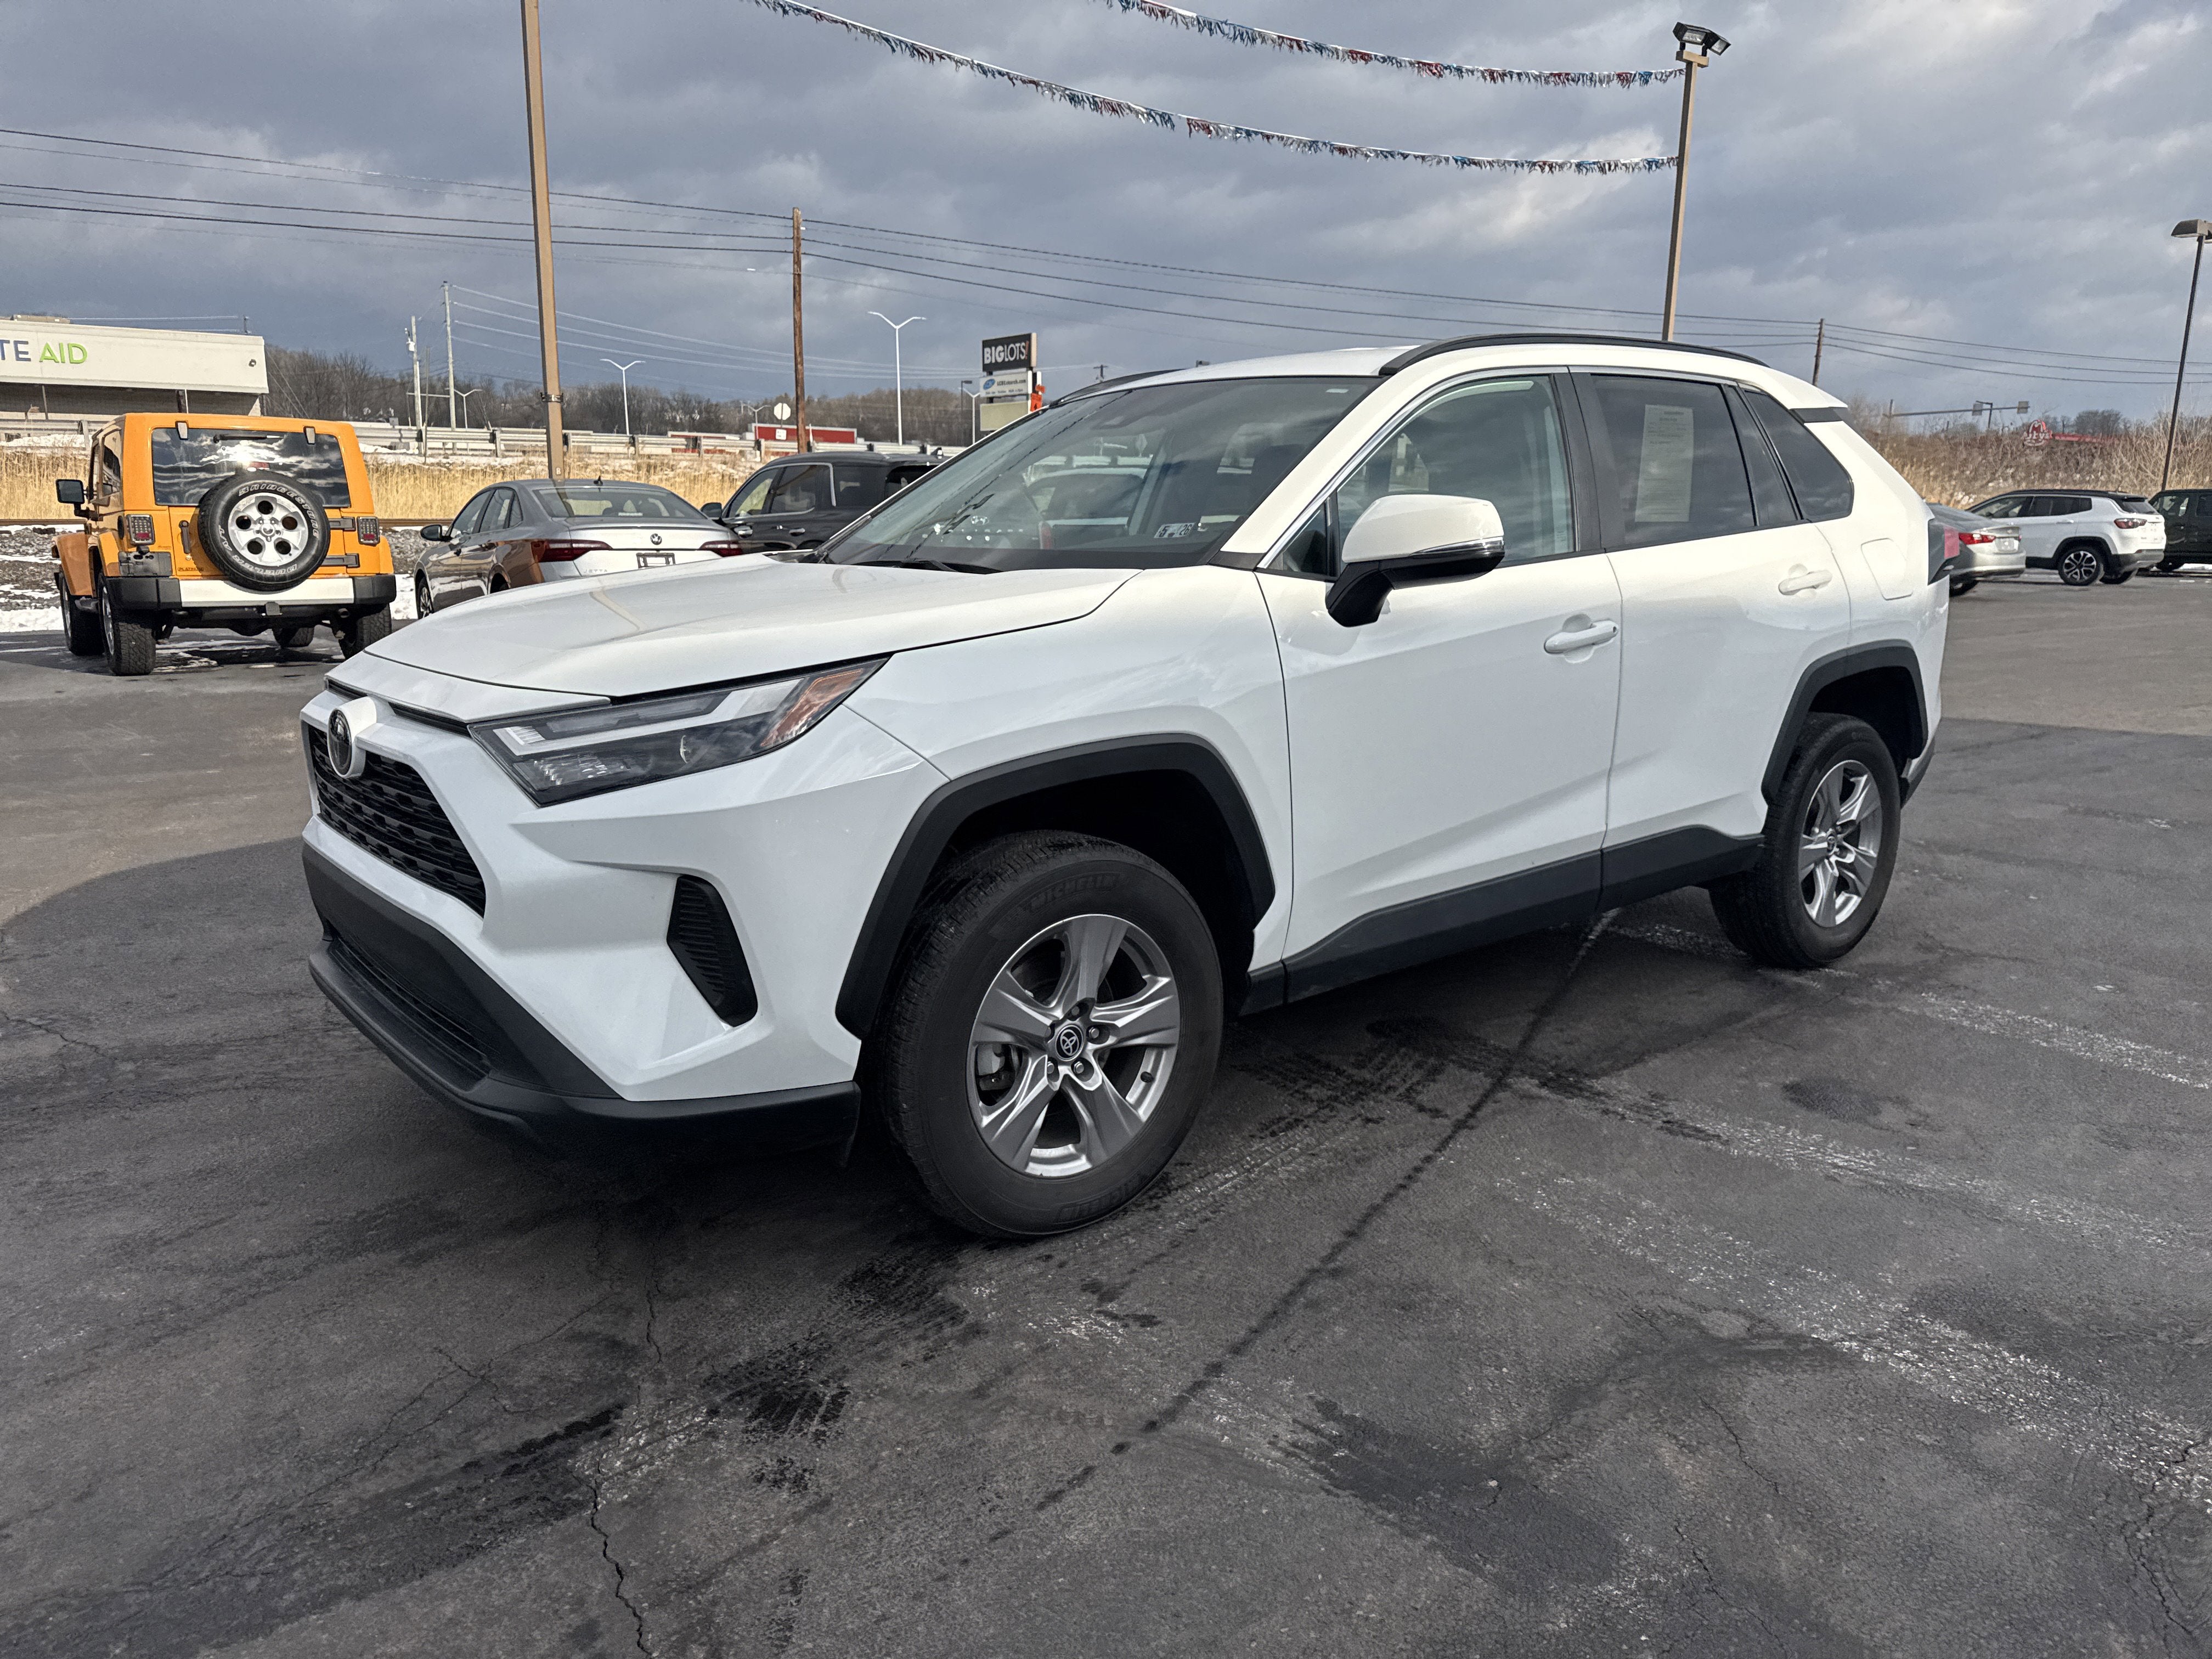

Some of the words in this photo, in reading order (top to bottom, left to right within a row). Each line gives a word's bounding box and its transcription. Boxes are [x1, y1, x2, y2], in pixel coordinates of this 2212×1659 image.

[39, 342, 88, 364] AID
[239, 483, 319, 540] BRIDGESTONE
[1159, 526, 1169, 537] 5
[232, 554, 297, 575] DUELER
